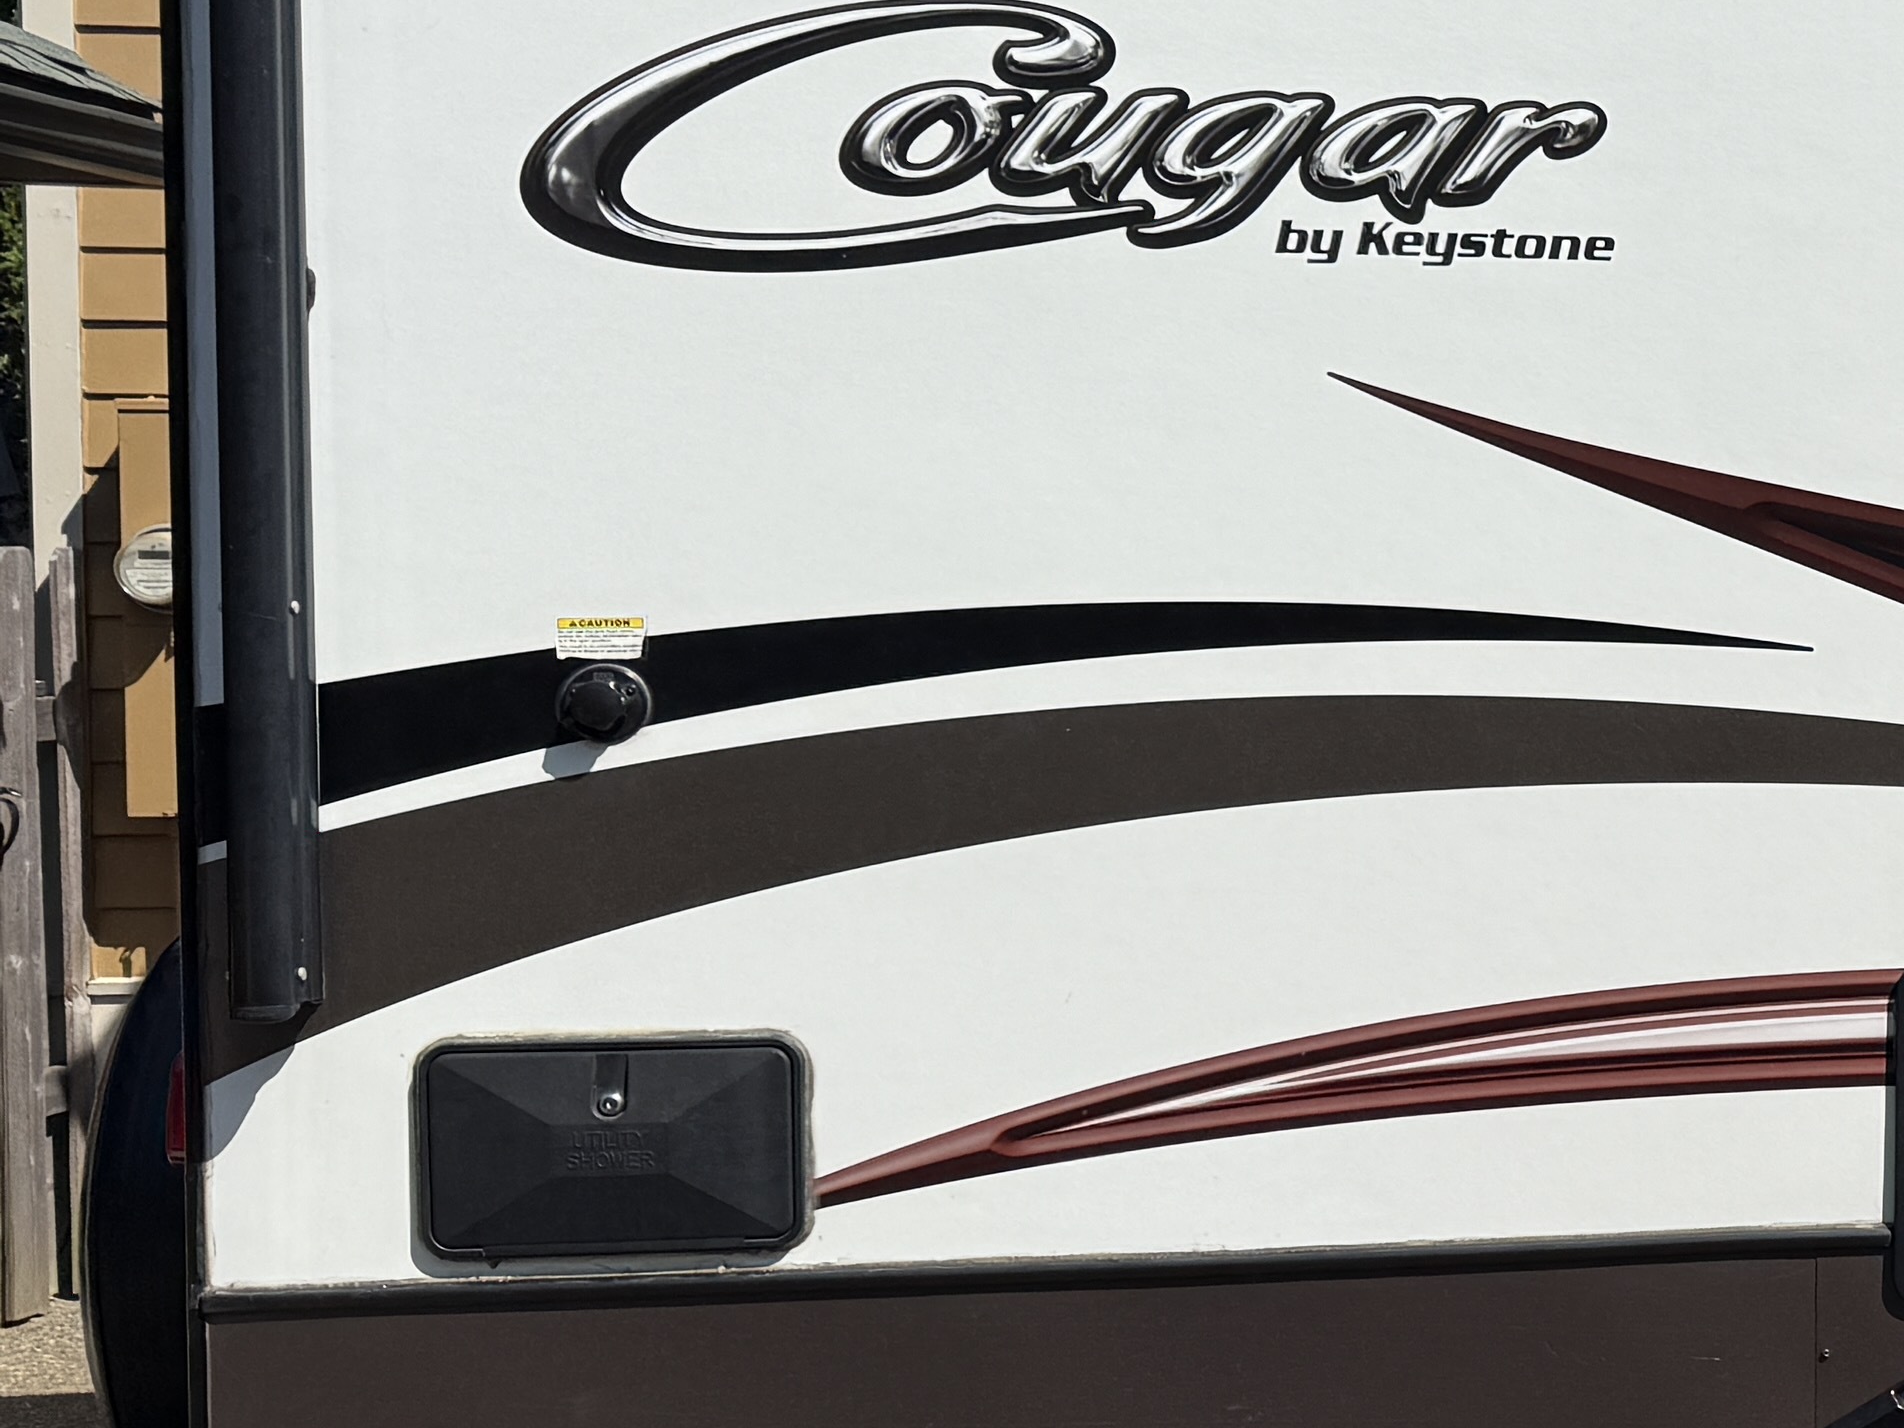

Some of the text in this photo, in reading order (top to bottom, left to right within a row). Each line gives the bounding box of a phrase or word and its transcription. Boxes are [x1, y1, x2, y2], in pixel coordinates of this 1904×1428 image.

[1275, 219, 1615, 267] by Keystone
[578, 619, 631, 627] CAUTION
[570, 1129, 648, 1149] UTILITY
[567, 1149, 656, 1170] SHOWER
